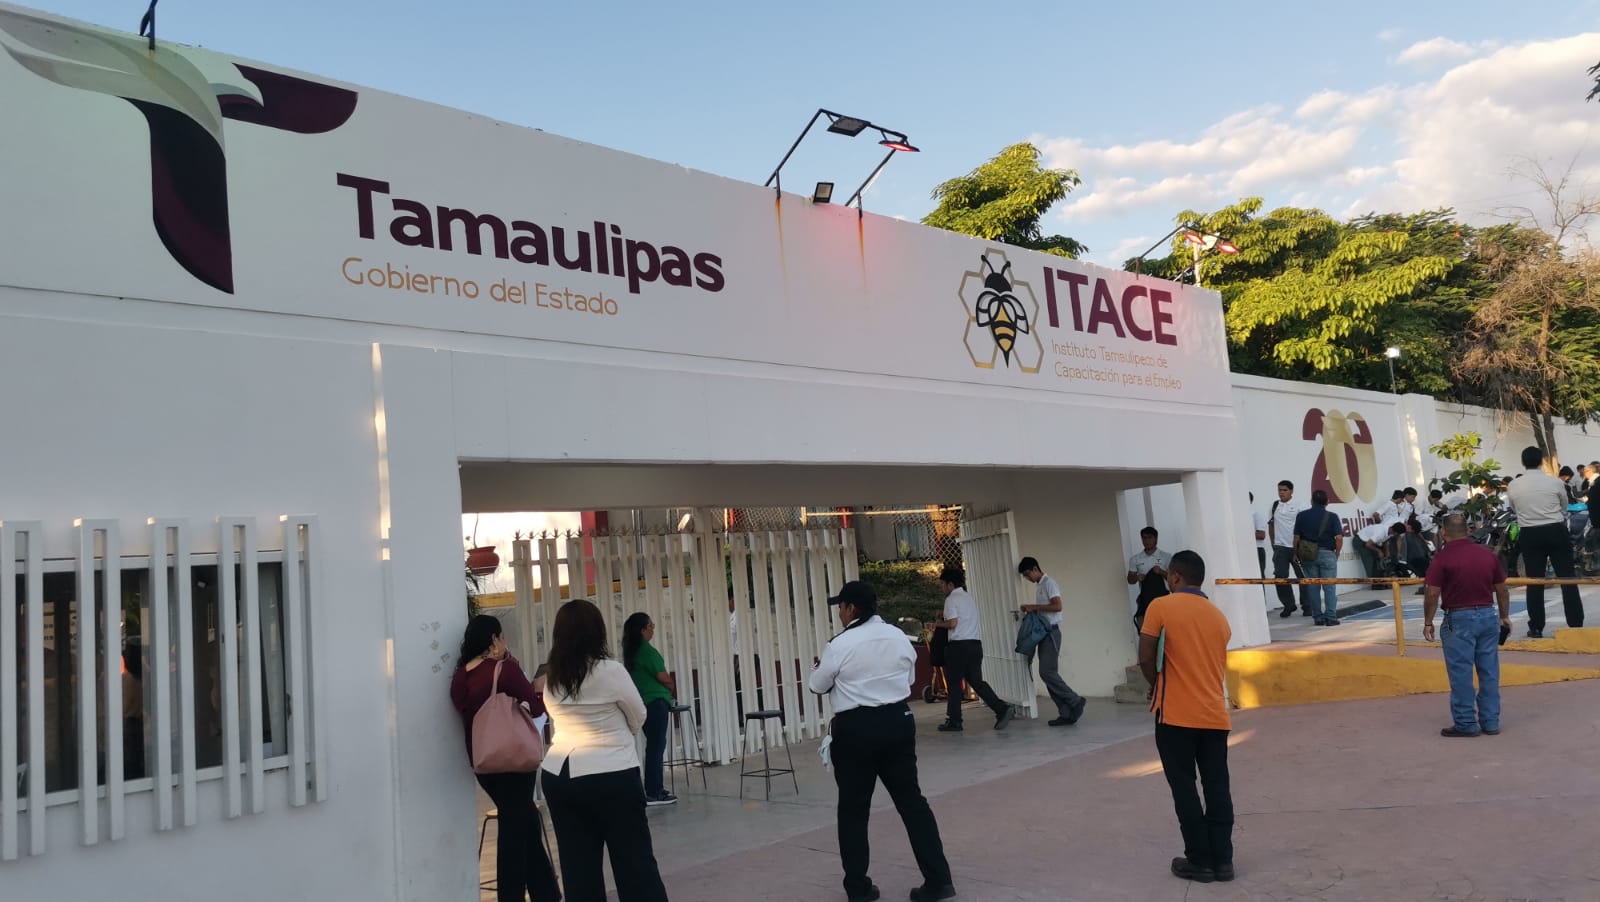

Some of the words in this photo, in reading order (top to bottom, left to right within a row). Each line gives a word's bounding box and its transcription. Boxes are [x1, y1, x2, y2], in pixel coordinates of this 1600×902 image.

[336, 172, 724, 294] Tamaulipas
[342, 257, 480, 299] Gobierno
[489, 278, 527, 304] del
[535, 283, 618, 316] Estado
[1043, 266, 1178, 346] ITACE
[1051, 339, 1097, 360] Instituto
[1098, 346, 1154, 367] Tamaulipeco
[1158, 354, 1169, 368] de
[1054, 361, 1120, 384] Capacitación
[1123, 373, 1142, 388] para
[1145, 374, 1153, 386] el
[1153, 373, 1182, 391] Empleo
